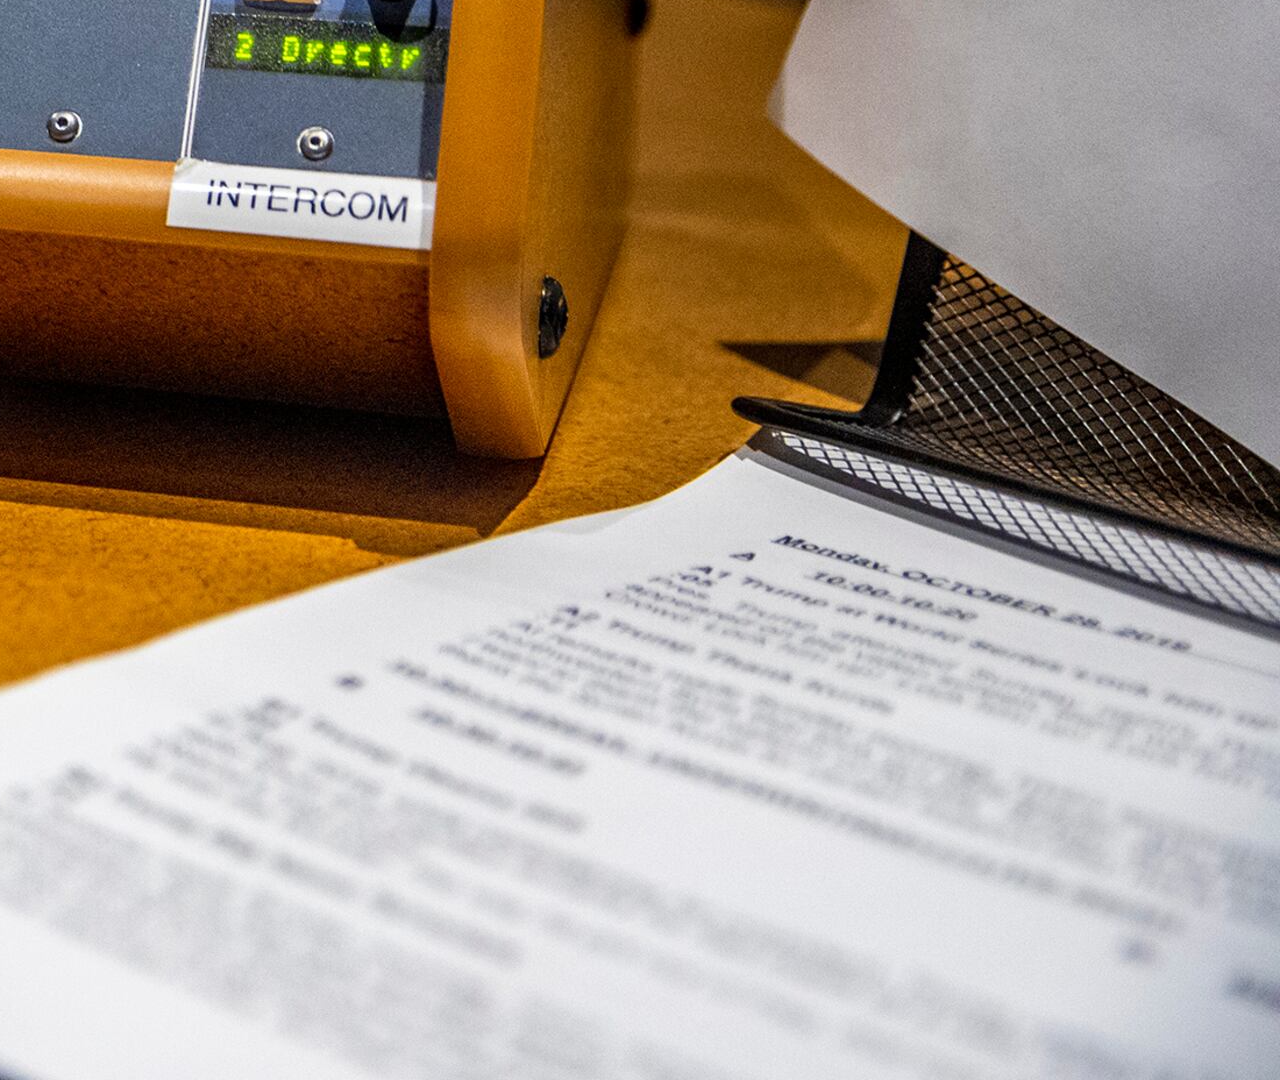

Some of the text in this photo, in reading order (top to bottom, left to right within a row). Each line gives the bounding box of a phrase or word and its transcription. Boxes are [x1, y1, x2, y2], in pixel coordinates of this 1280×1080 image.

[234, 32, 422, 70] 2 Drectr
[206, 178, 410, 223] INTERCOM
[740, 575, 830, 608] Trump
[900, 568, 1057, 617] OCTOBER
